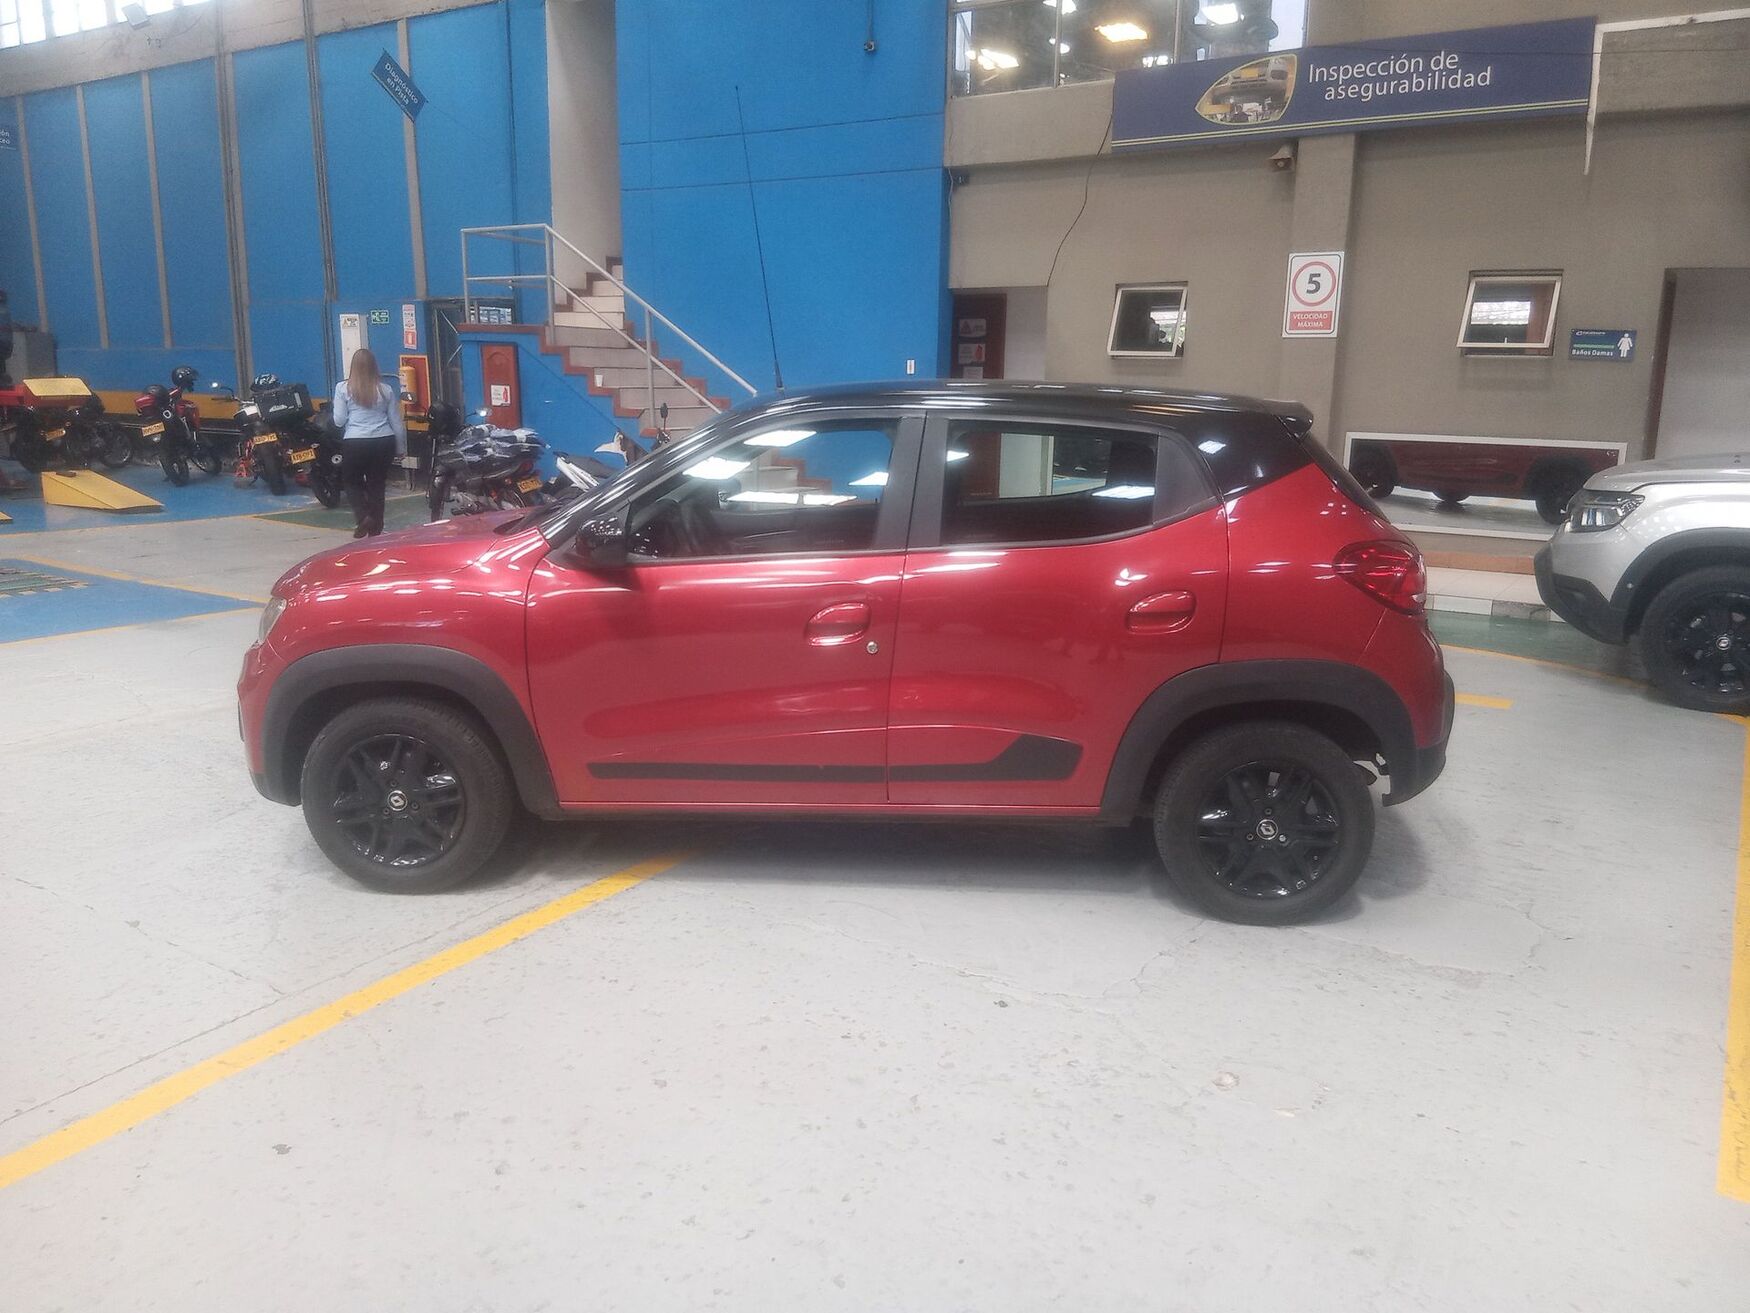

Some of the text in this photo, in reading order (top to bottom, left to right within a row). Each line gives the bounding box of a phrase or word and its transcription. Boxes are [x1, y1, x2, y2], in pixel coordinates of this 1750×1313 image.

[384, 62, 419, 104] Diagnóstico
[1309, 50, 1459, 84] Inspección de
[1325, 66, 1491, 102] asegurabilidad
[1306, 273, 1321, 294] 5
[1297, 320, 1323, 328] MÁXIMA
